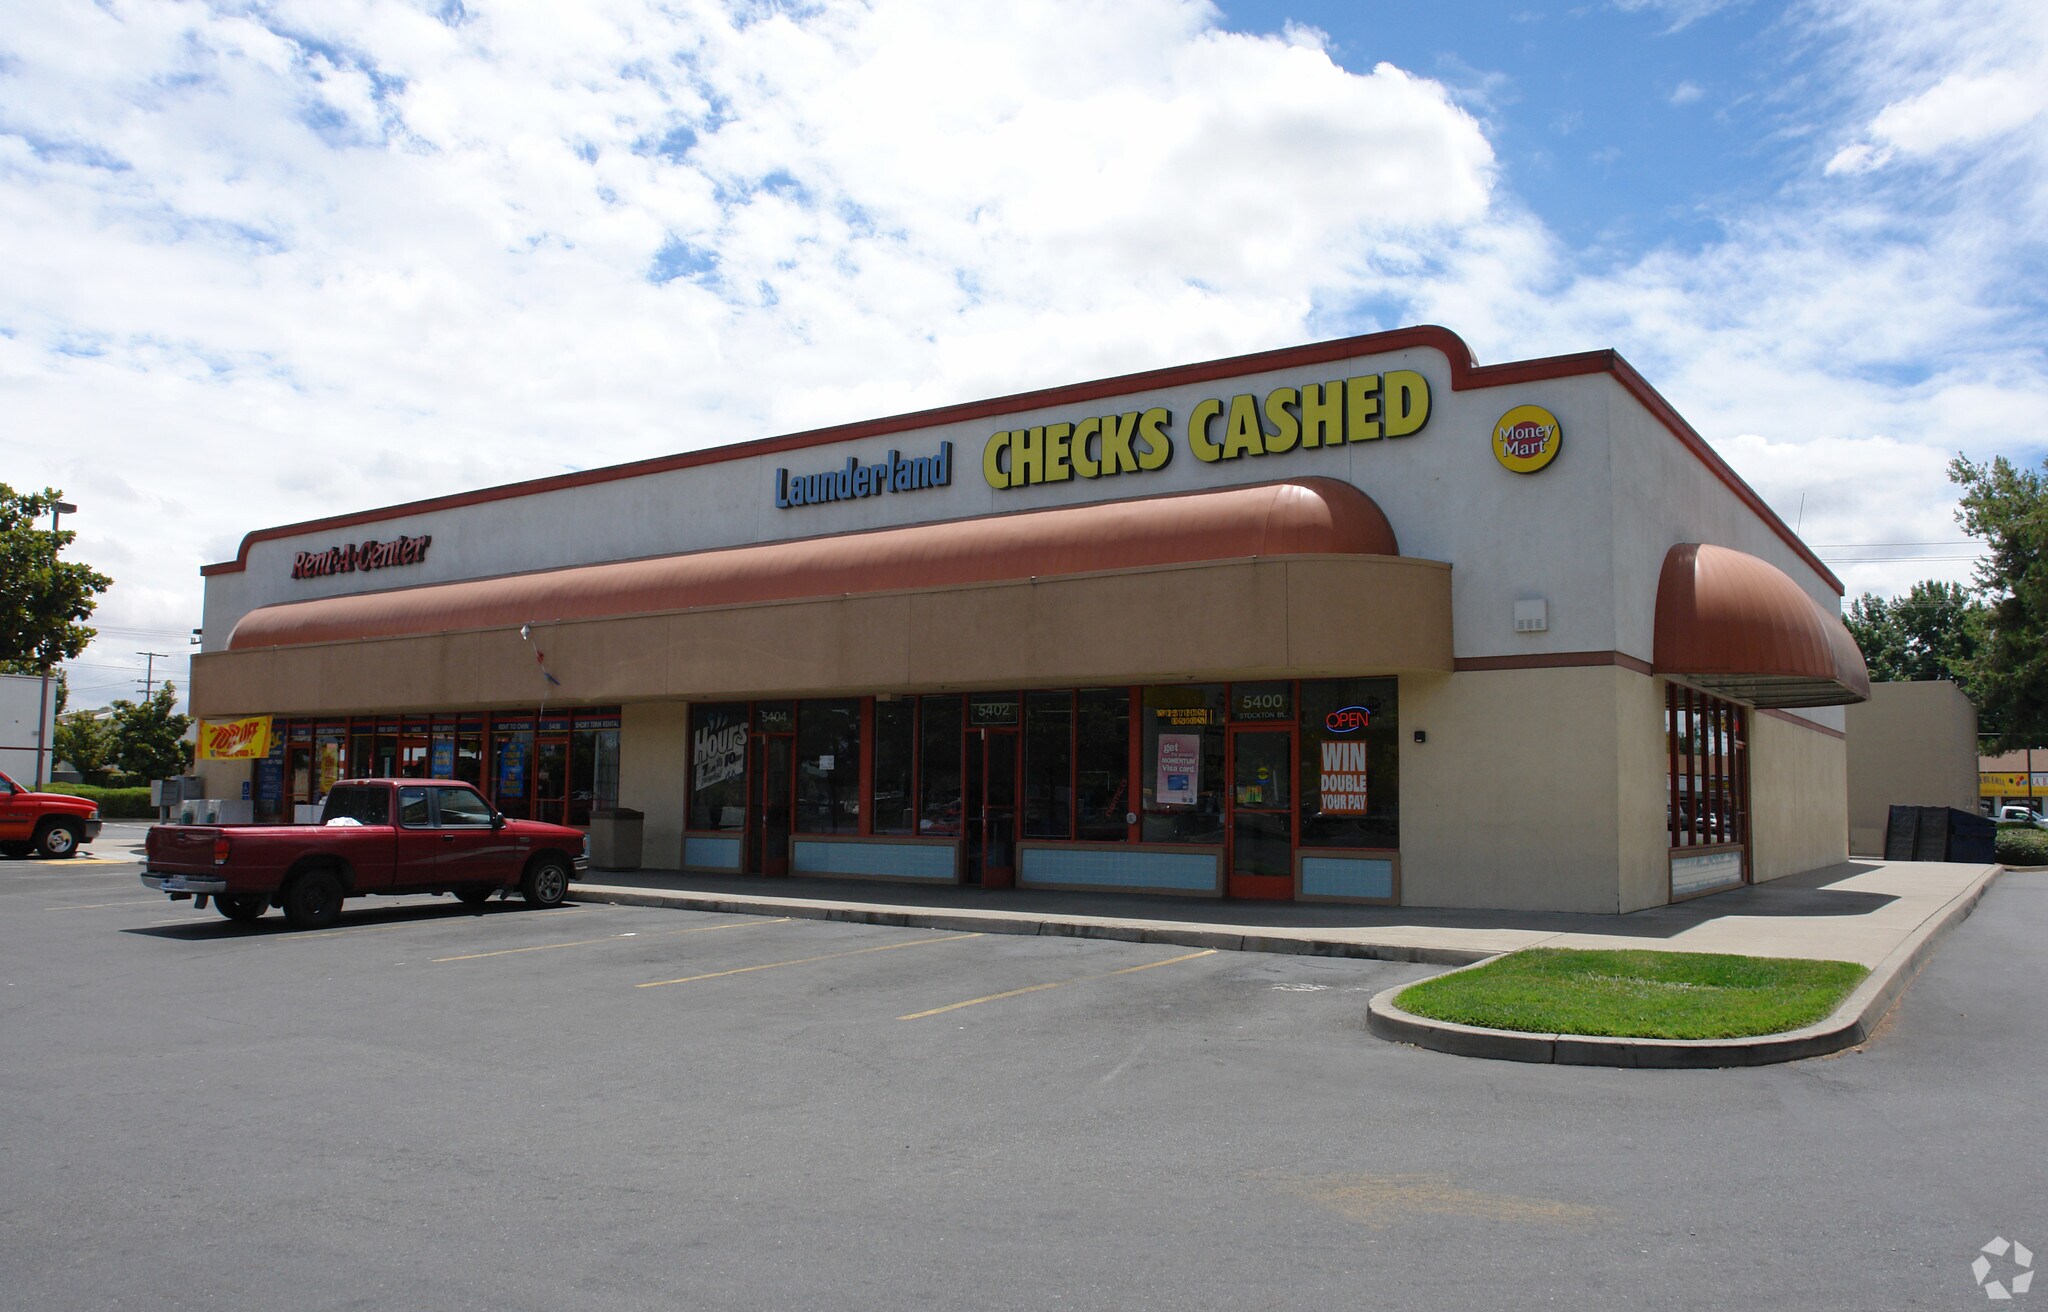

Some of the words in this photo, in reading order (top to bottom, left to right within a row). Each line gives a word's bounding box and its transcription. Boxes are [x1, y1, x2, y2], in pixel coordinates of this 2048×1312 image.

[982, 406, 1174, 490] CHECKS
[1187, 369, 1432, 464] CASHED
[1499, 424, 1555, 442] Money
[1503, 440, 1547, 457] Mart
[775, 440, 953, 509] Launderland
[1242, 694, 1283, 709] 5400
[761, 711, 787, 722] 5404
[978, 704, 1010, 717] 5402
[1156, 708, 1205, 717] WESTERN
[1239, 711, 1275, 720] STOCKTON
[603, 720, 620, 728] RENTAL
[1171, 717, 1205, 725] UNION
[1325, 712, 1369, 728] OPEN
[694, 722, 749, 766] Hours
[1163, 743, 1179, 754] get
[1161, 757, 1196, 765] MOMENTUM
[1321, 742, 1366, 772] WIN
[1162, 764, 1178, 772] Visa
[1320, 774, 1367, 792] DOUBLE
[1321, 794, 1347, 810] YOUR
[1347, 794, 1367, 810] PAY
